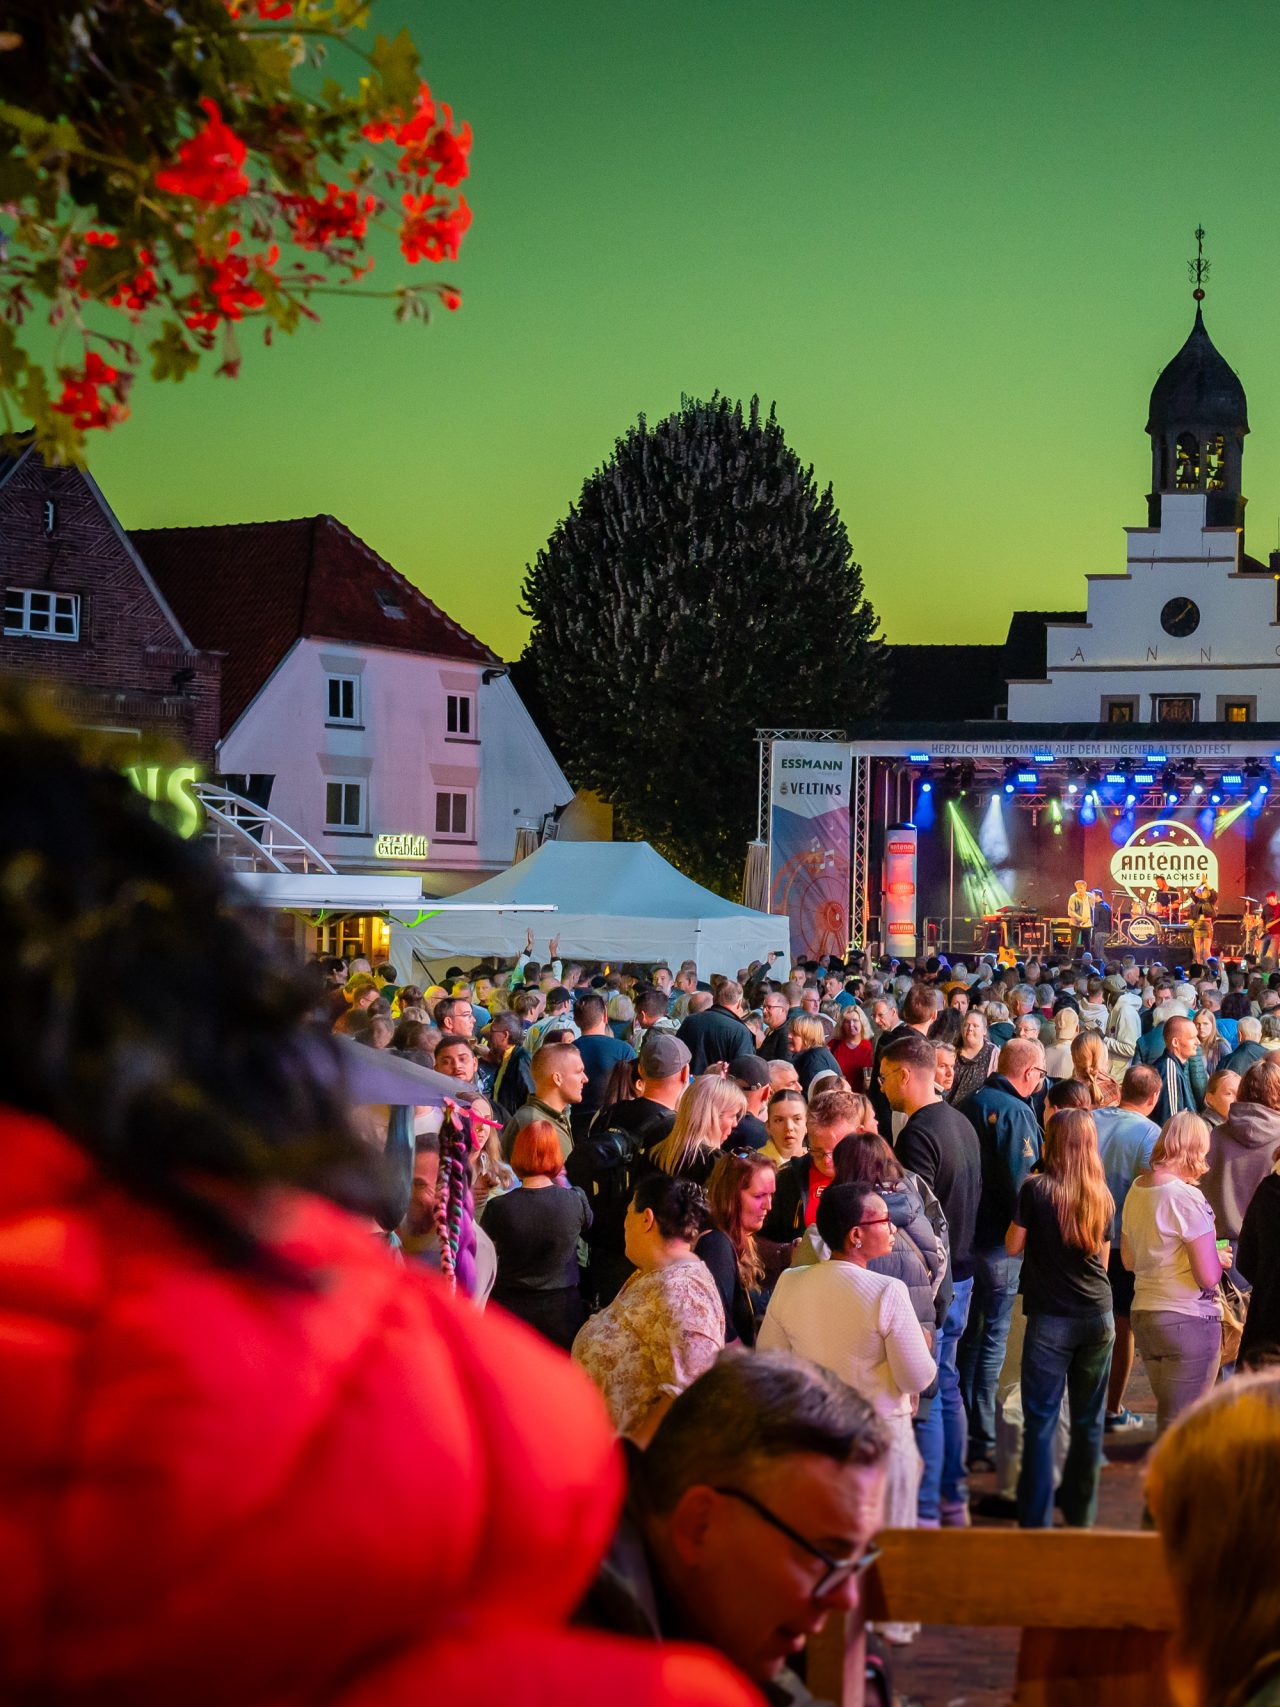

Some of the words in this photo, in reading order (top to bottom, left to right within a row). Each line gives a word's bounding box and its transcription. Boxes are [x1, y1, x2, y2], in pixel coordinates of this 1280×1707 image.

[930, 744, 979, 754] HERZLICH
[982, 744, 1052, 755] WILLKOMMEN
[1055, 744, 1075, 754] AUF
[1078, 744, 1100, 754] DEM
[1104, 744, 1154, 755] LINGENER
[1158, 744, 1232, 755] ALTSTADTFEST
[781, 759, 843, 771] ESSMANN
[790, 782, 842, 796] VELTINS
[378, 836, 426, 856] extrablatt
[1121, 851, 1208, 870] antenne
